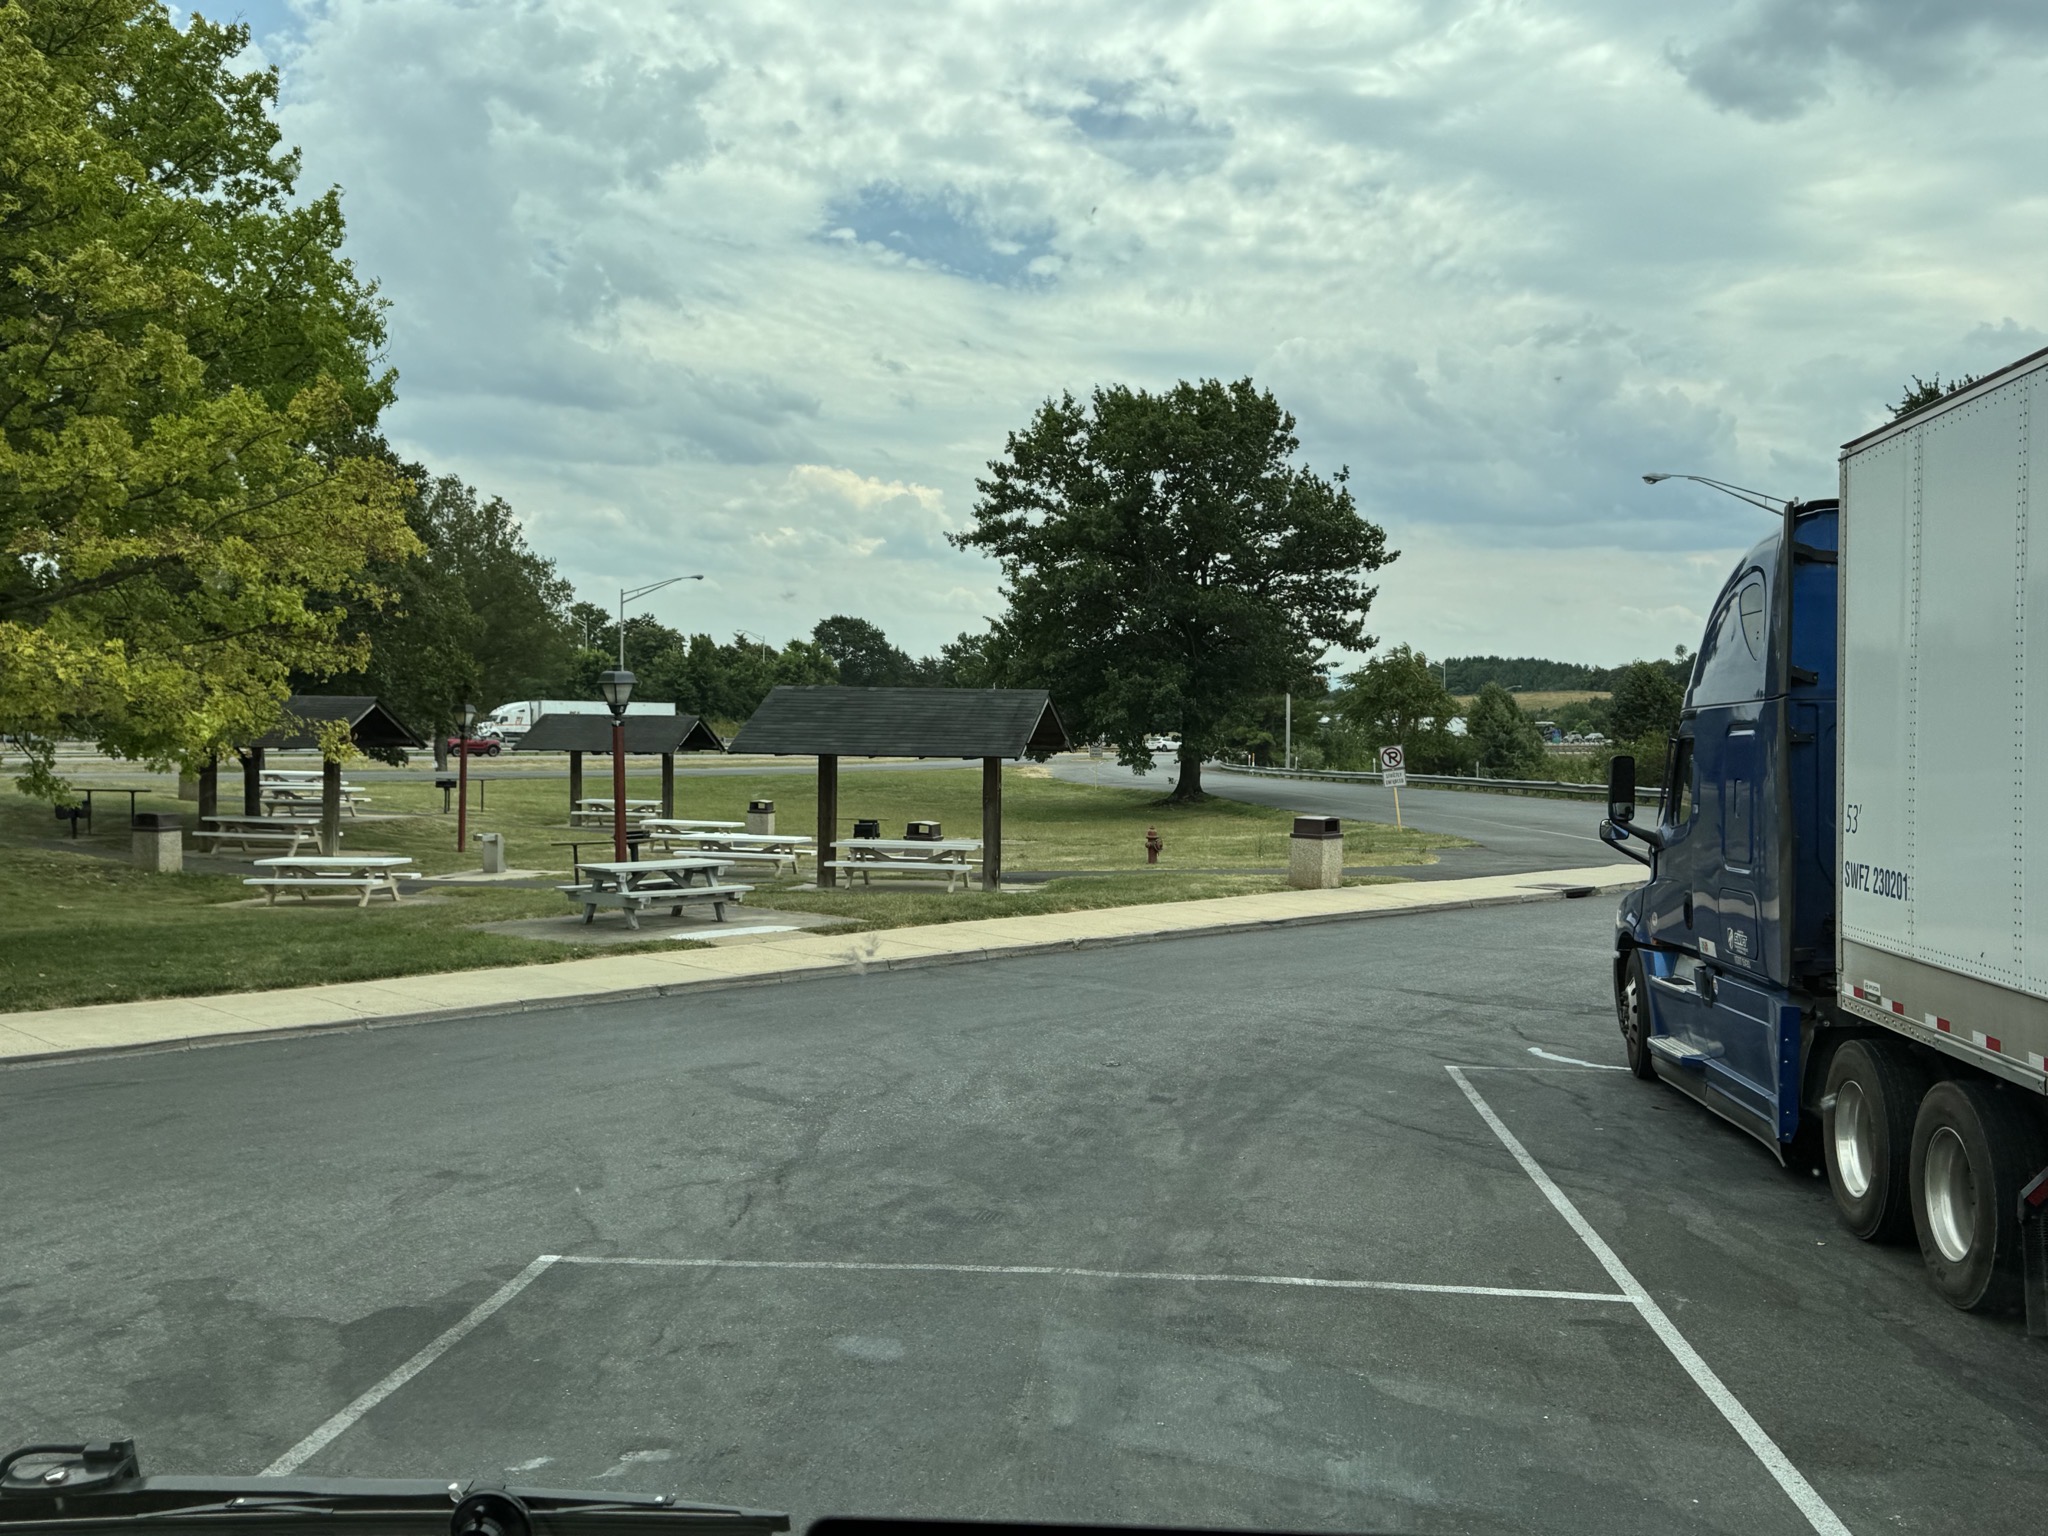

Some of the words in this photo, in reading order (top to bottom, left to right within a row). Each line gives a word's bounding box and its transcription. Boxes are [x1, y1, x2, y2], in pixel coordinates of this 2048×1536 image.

[1845, 804, 1862, 834] 53'
[1845, 861, 1870, 892] SWFZ
[1873, 867, 1908, 901] 230201
